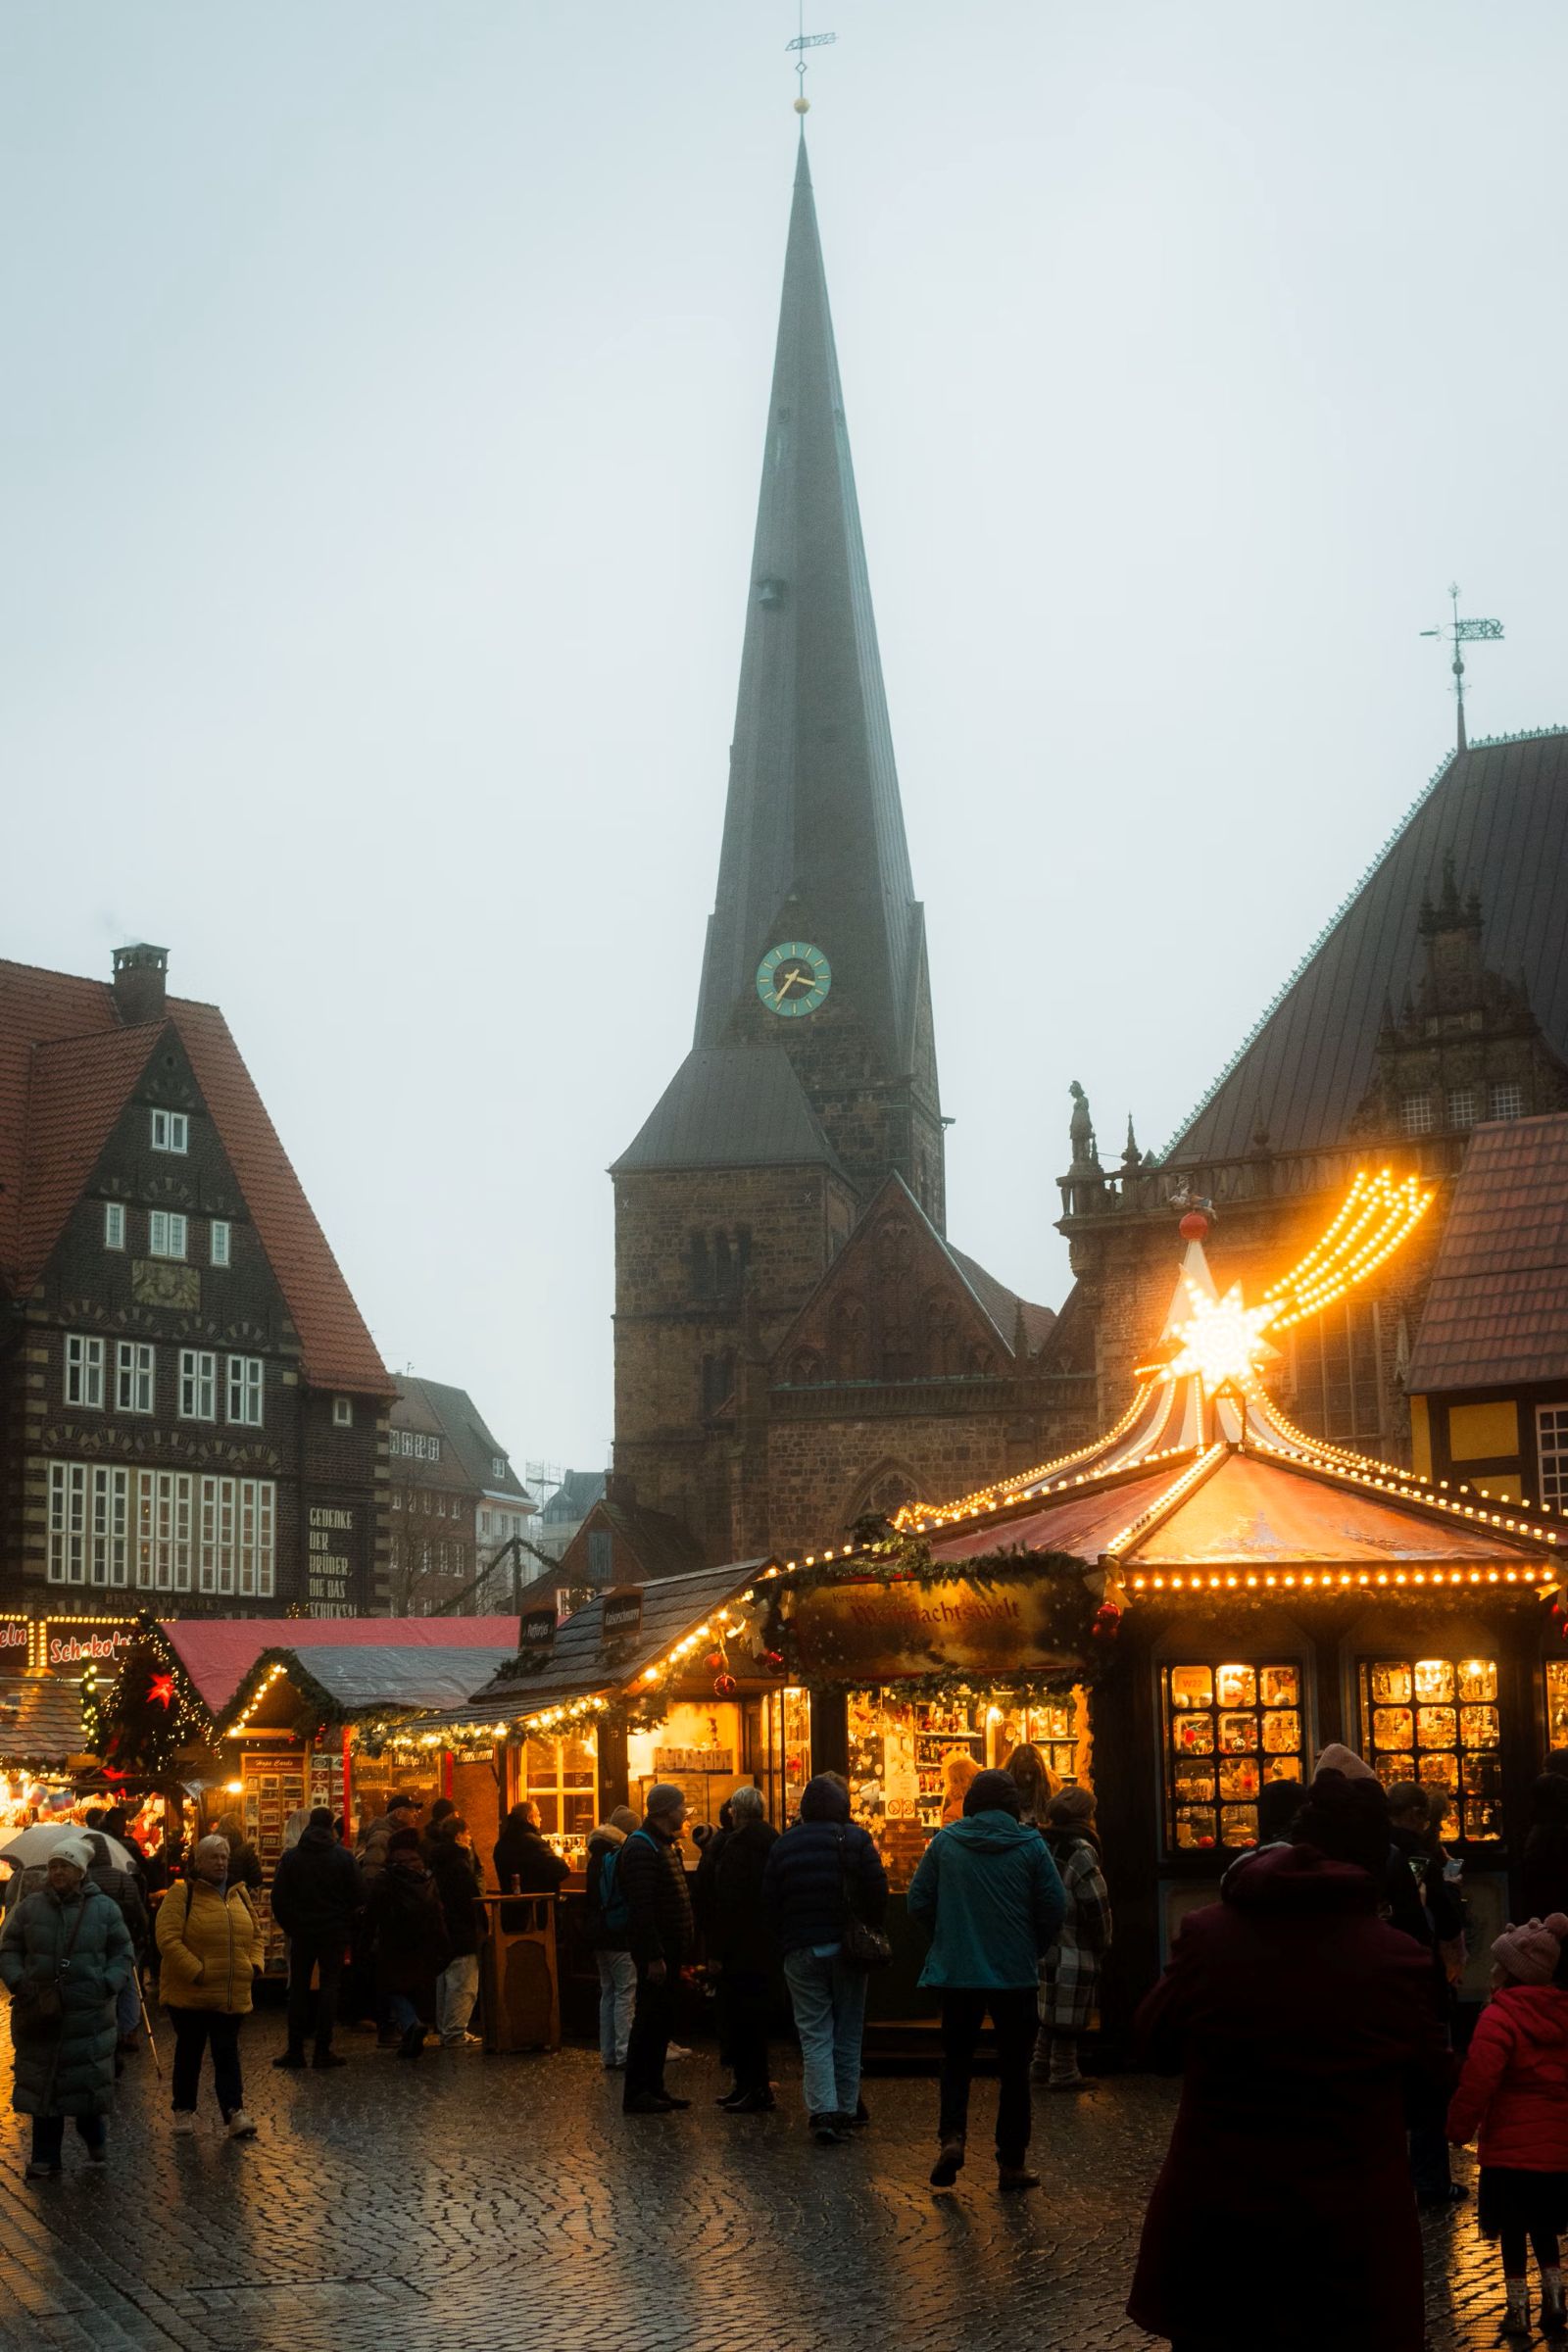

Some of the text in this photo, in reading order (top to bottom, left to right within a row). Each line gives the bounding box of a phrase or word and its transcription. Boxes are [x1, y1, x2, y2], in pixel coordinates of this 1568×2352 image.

[310, 1507, 353, 1530] GEDENKE
[309, 1531, 328, 1550] DER
[309, 1578, 346, 1598] DIE DAS
[850, 1597, 1020, 1626] Weihnachtswelt
[1182, 1679, 1203, 1688] W22
